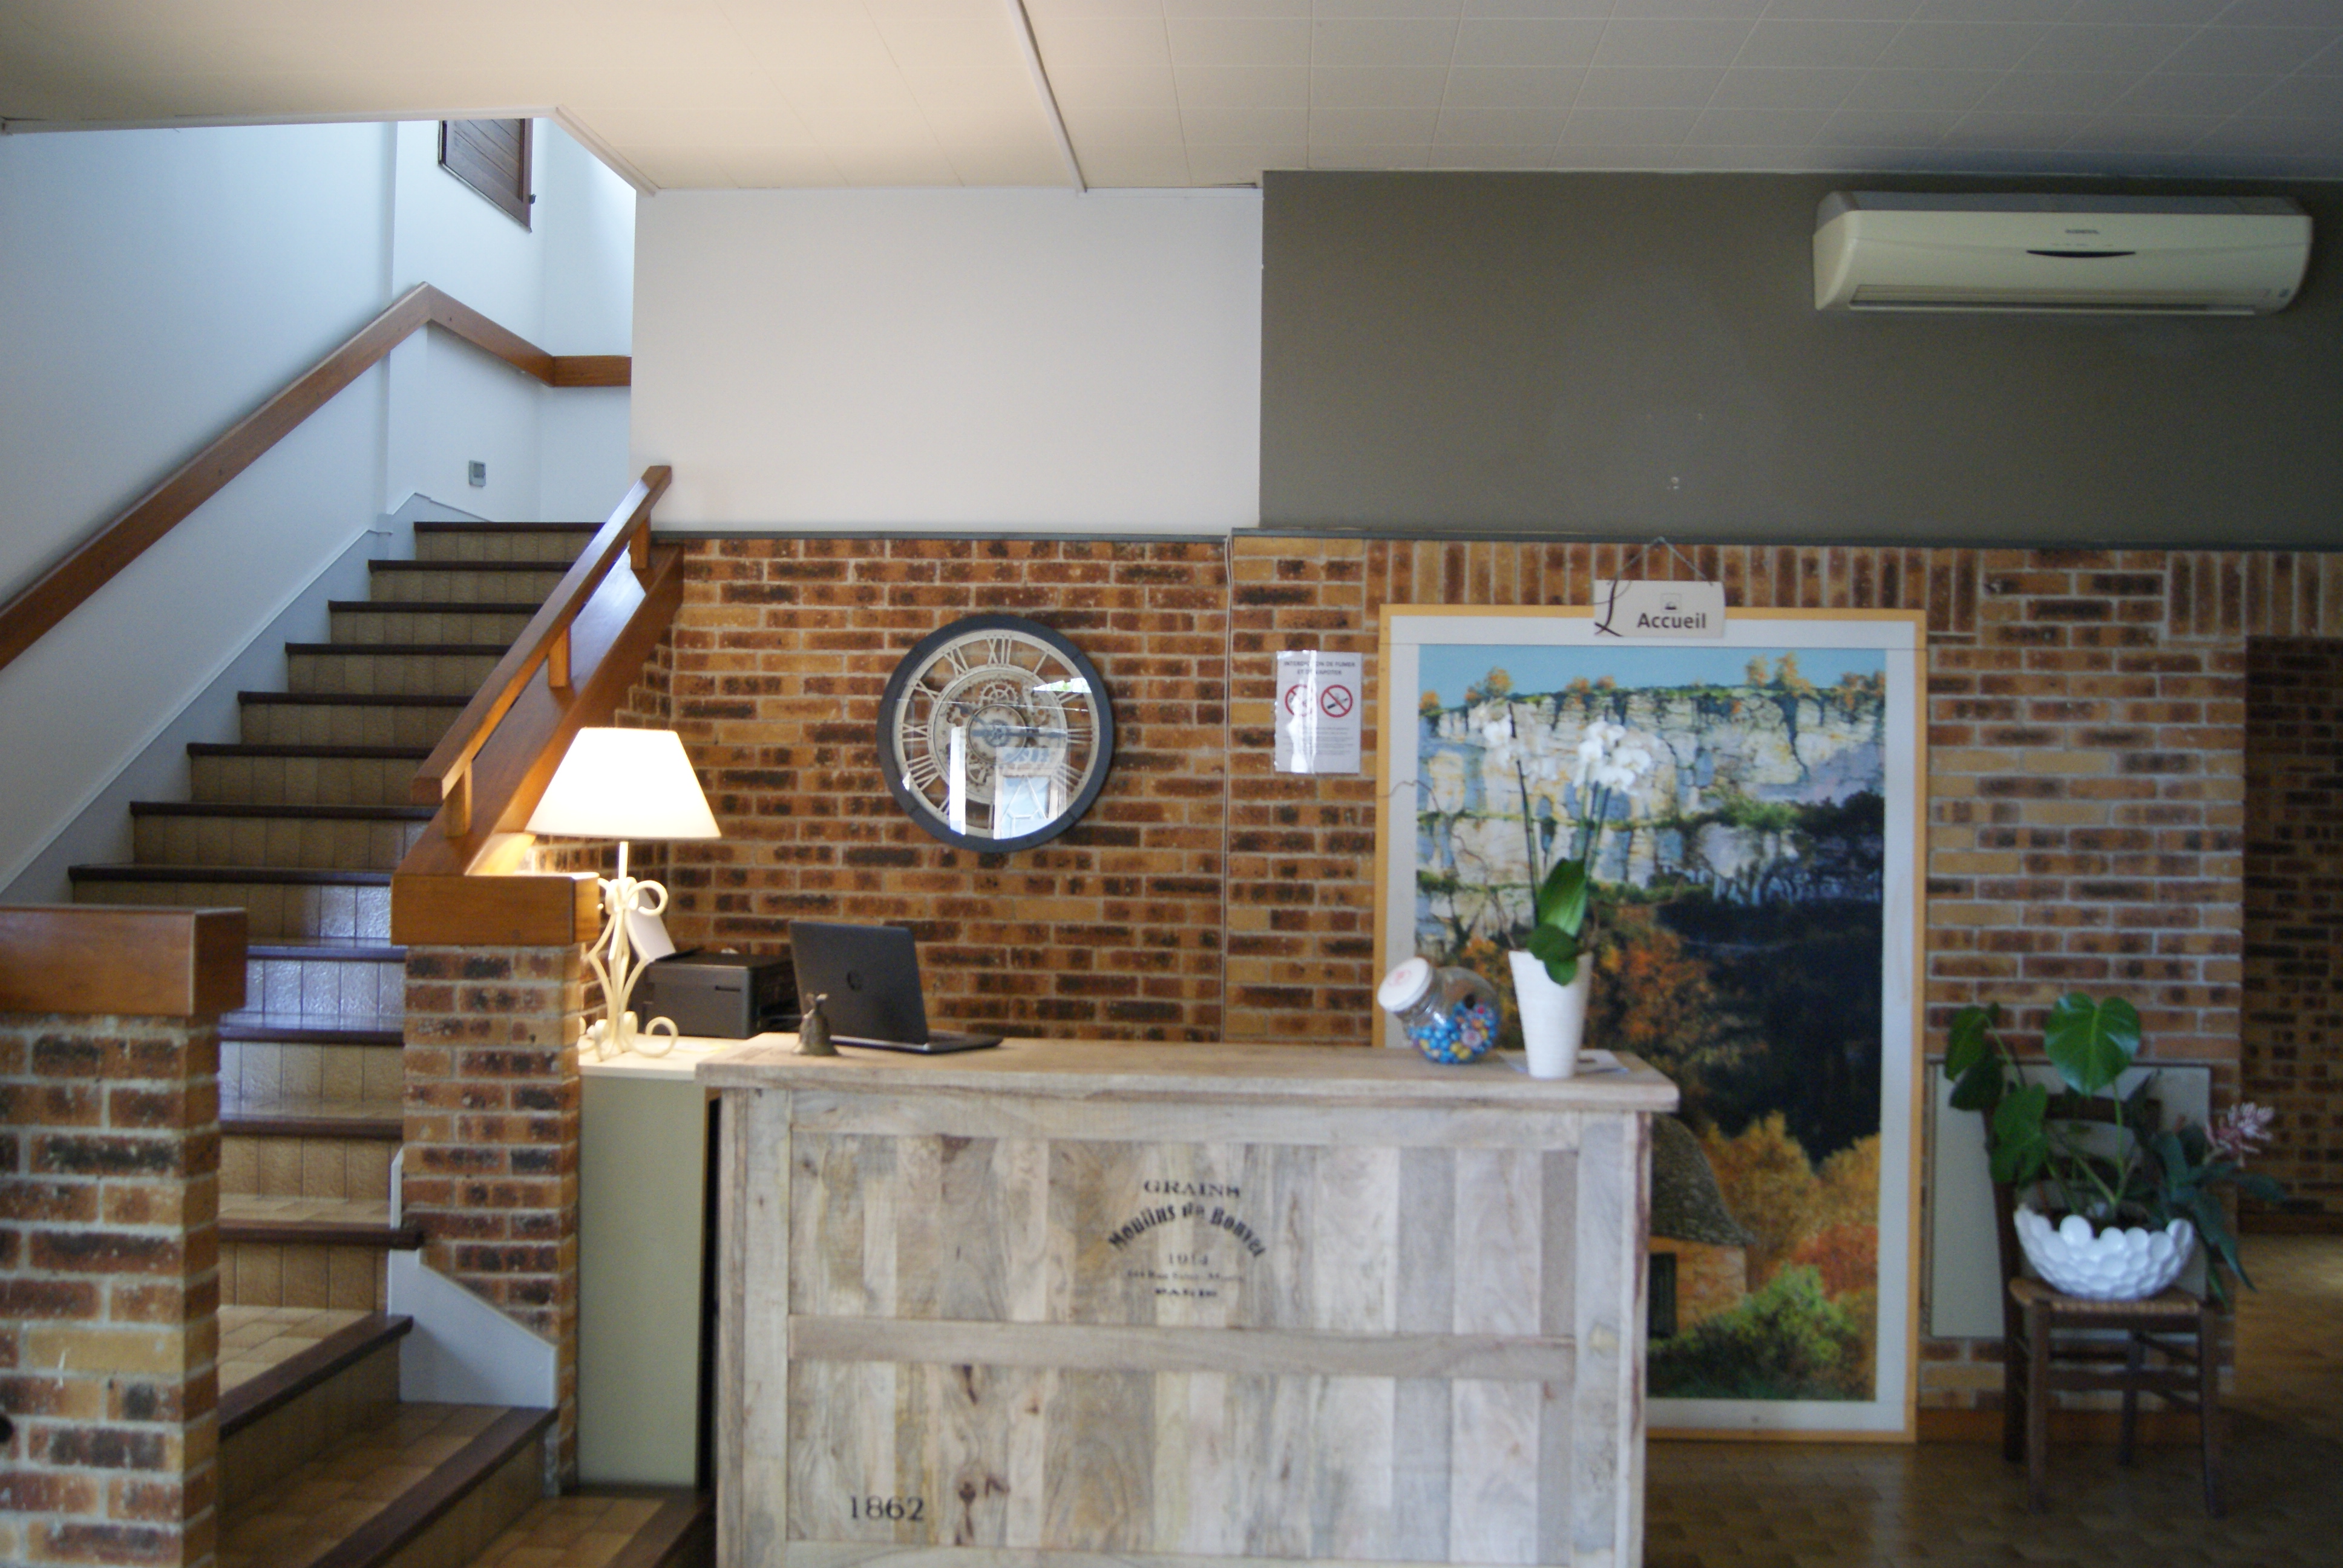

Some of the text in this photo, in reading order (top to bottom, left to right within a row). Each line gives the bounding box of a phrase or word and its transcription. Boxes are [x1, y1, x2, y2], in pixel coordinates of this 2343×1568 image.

[1637, 612, 1706, 629] Accueil
[1144, 1180, 1240, 1198] GRAINS
[1109, 1204, 1176, 1250] Moulins
[851, 1495, 924, 1521] 1862
